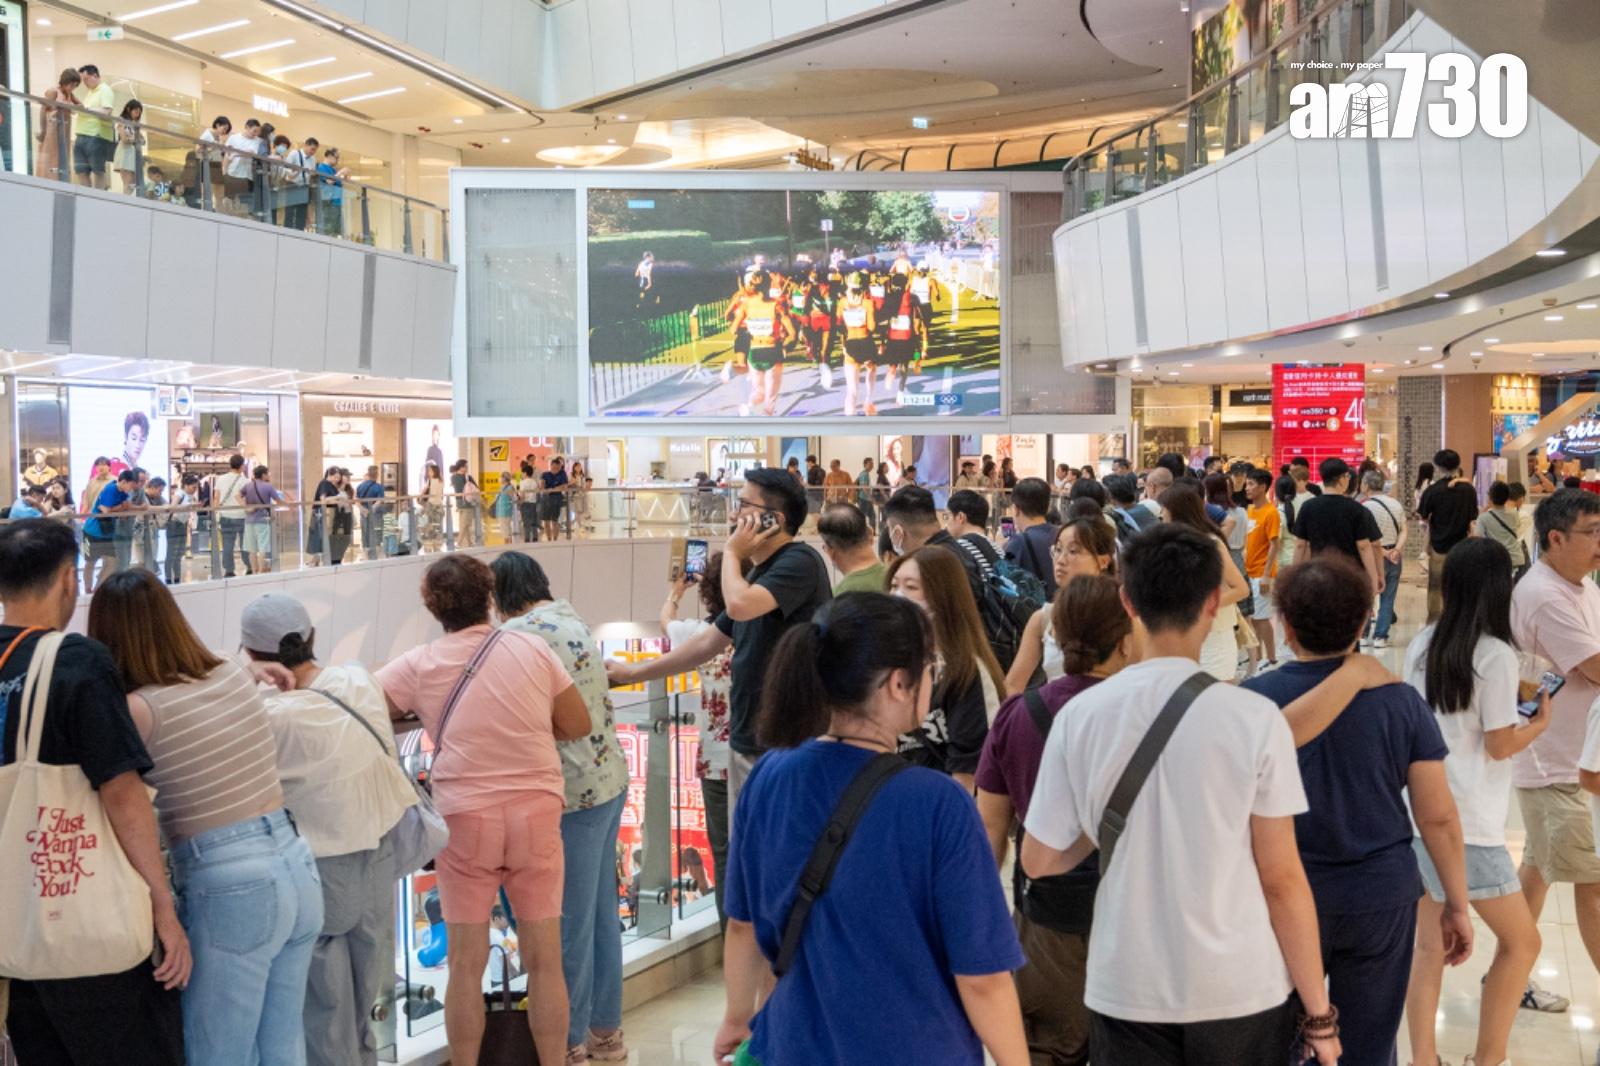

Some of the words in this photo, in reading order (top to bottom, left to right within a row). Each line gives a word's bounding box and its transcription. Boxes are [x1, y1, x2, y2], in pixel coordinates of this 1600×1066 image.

[48, 807, 86, 834] Just
[26, 830, 98, 854] Wanna
[33, 870, 80, 898] You!
